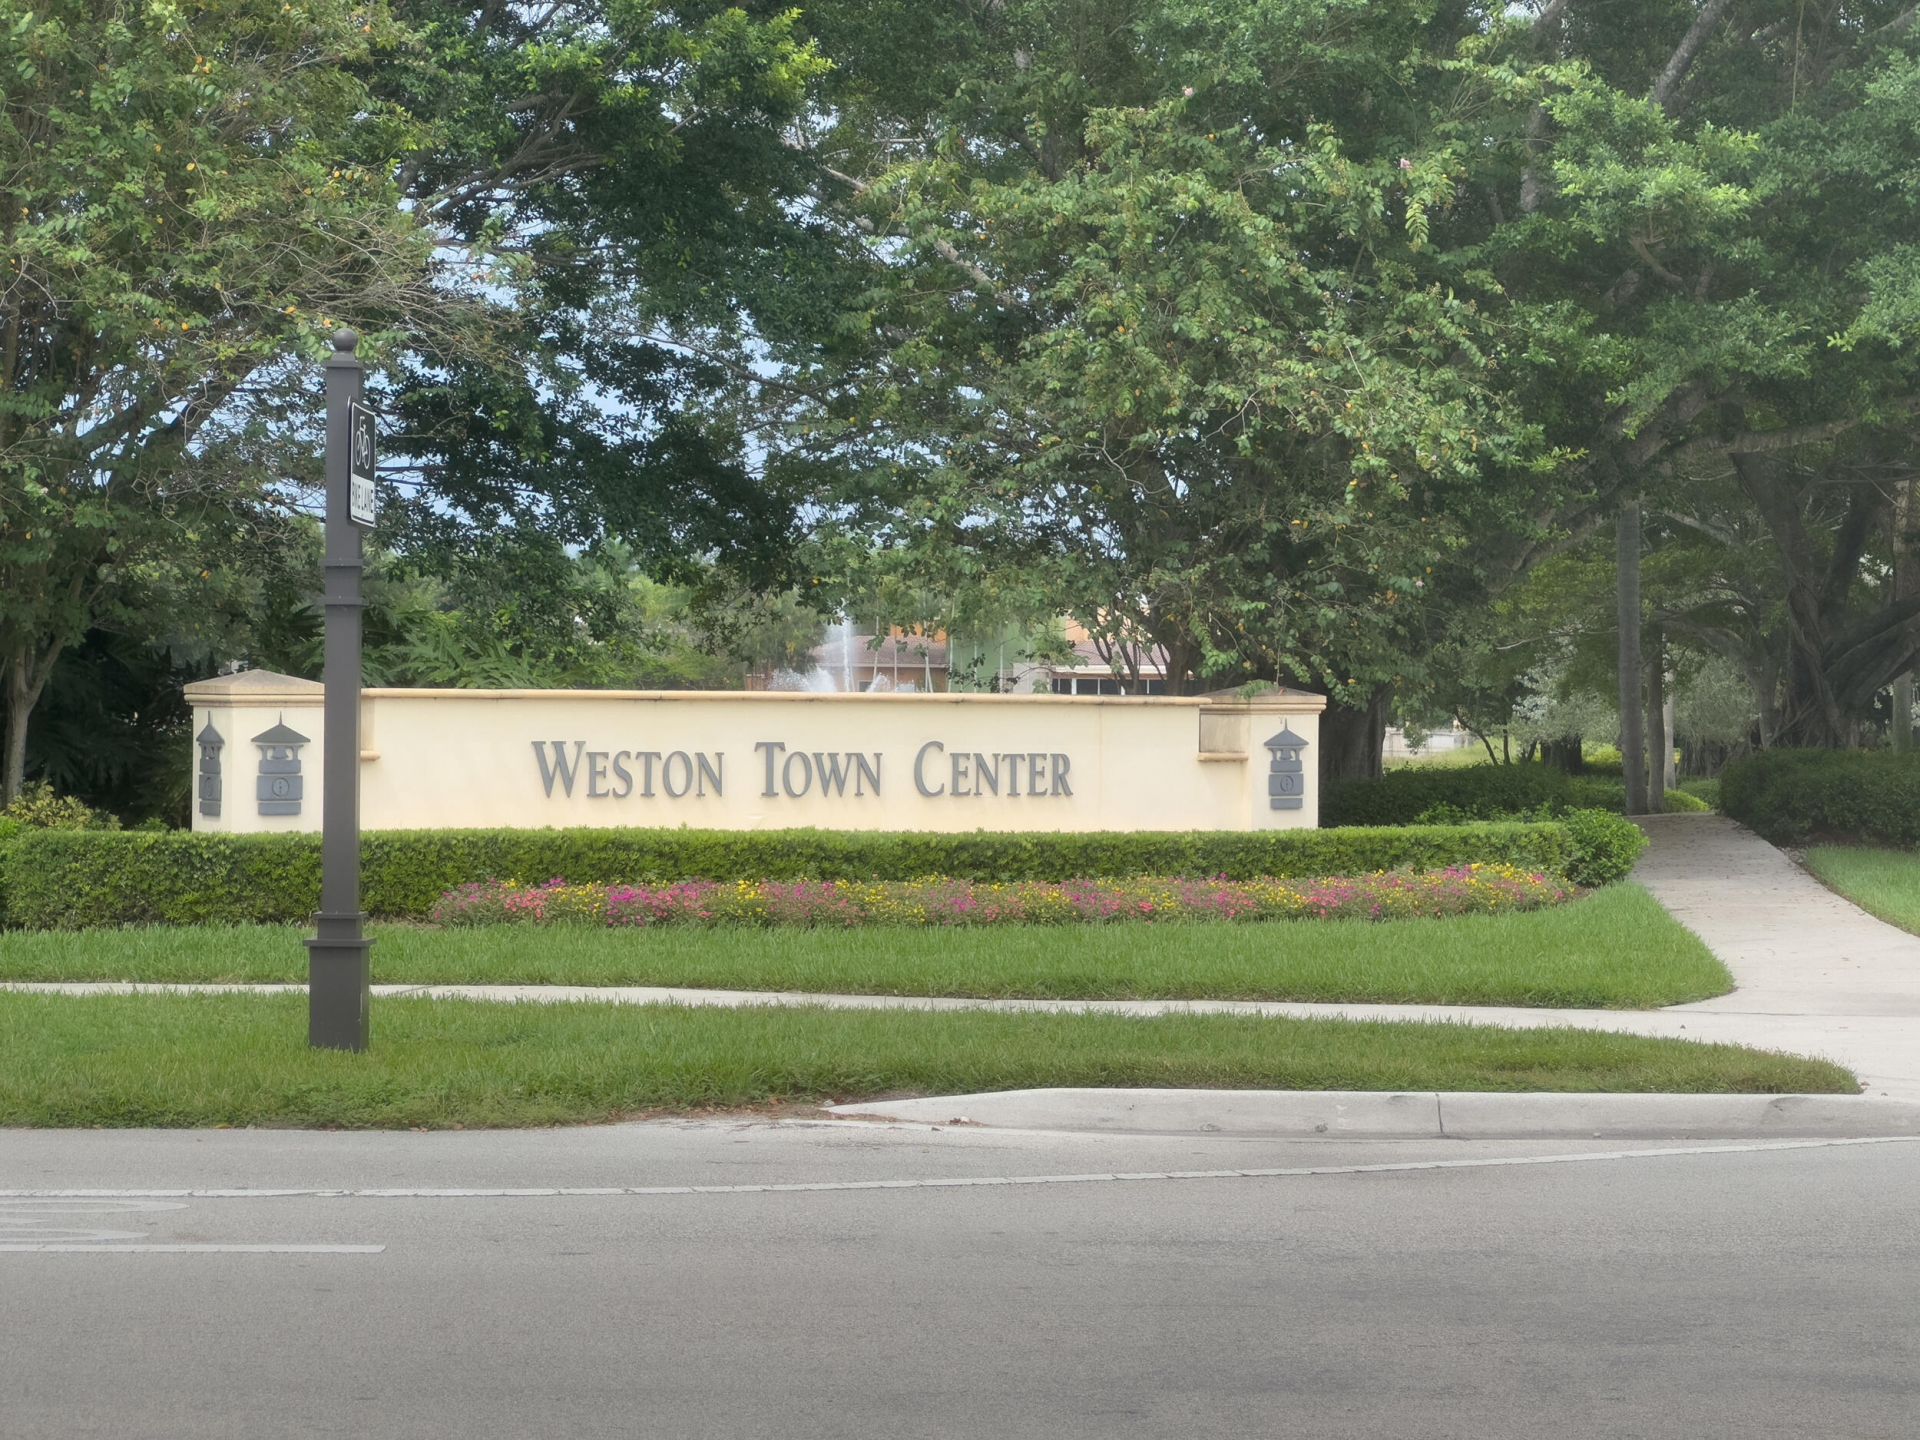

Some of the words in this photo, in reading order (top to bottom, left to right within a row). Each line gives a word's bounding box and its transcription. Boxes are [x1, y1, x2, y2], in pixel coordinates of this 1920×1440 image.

[531, 741, 724, 798] WESTON
[754, 741, 882, 799] TOWN
[913, 740, 1074, 798] CENTER
